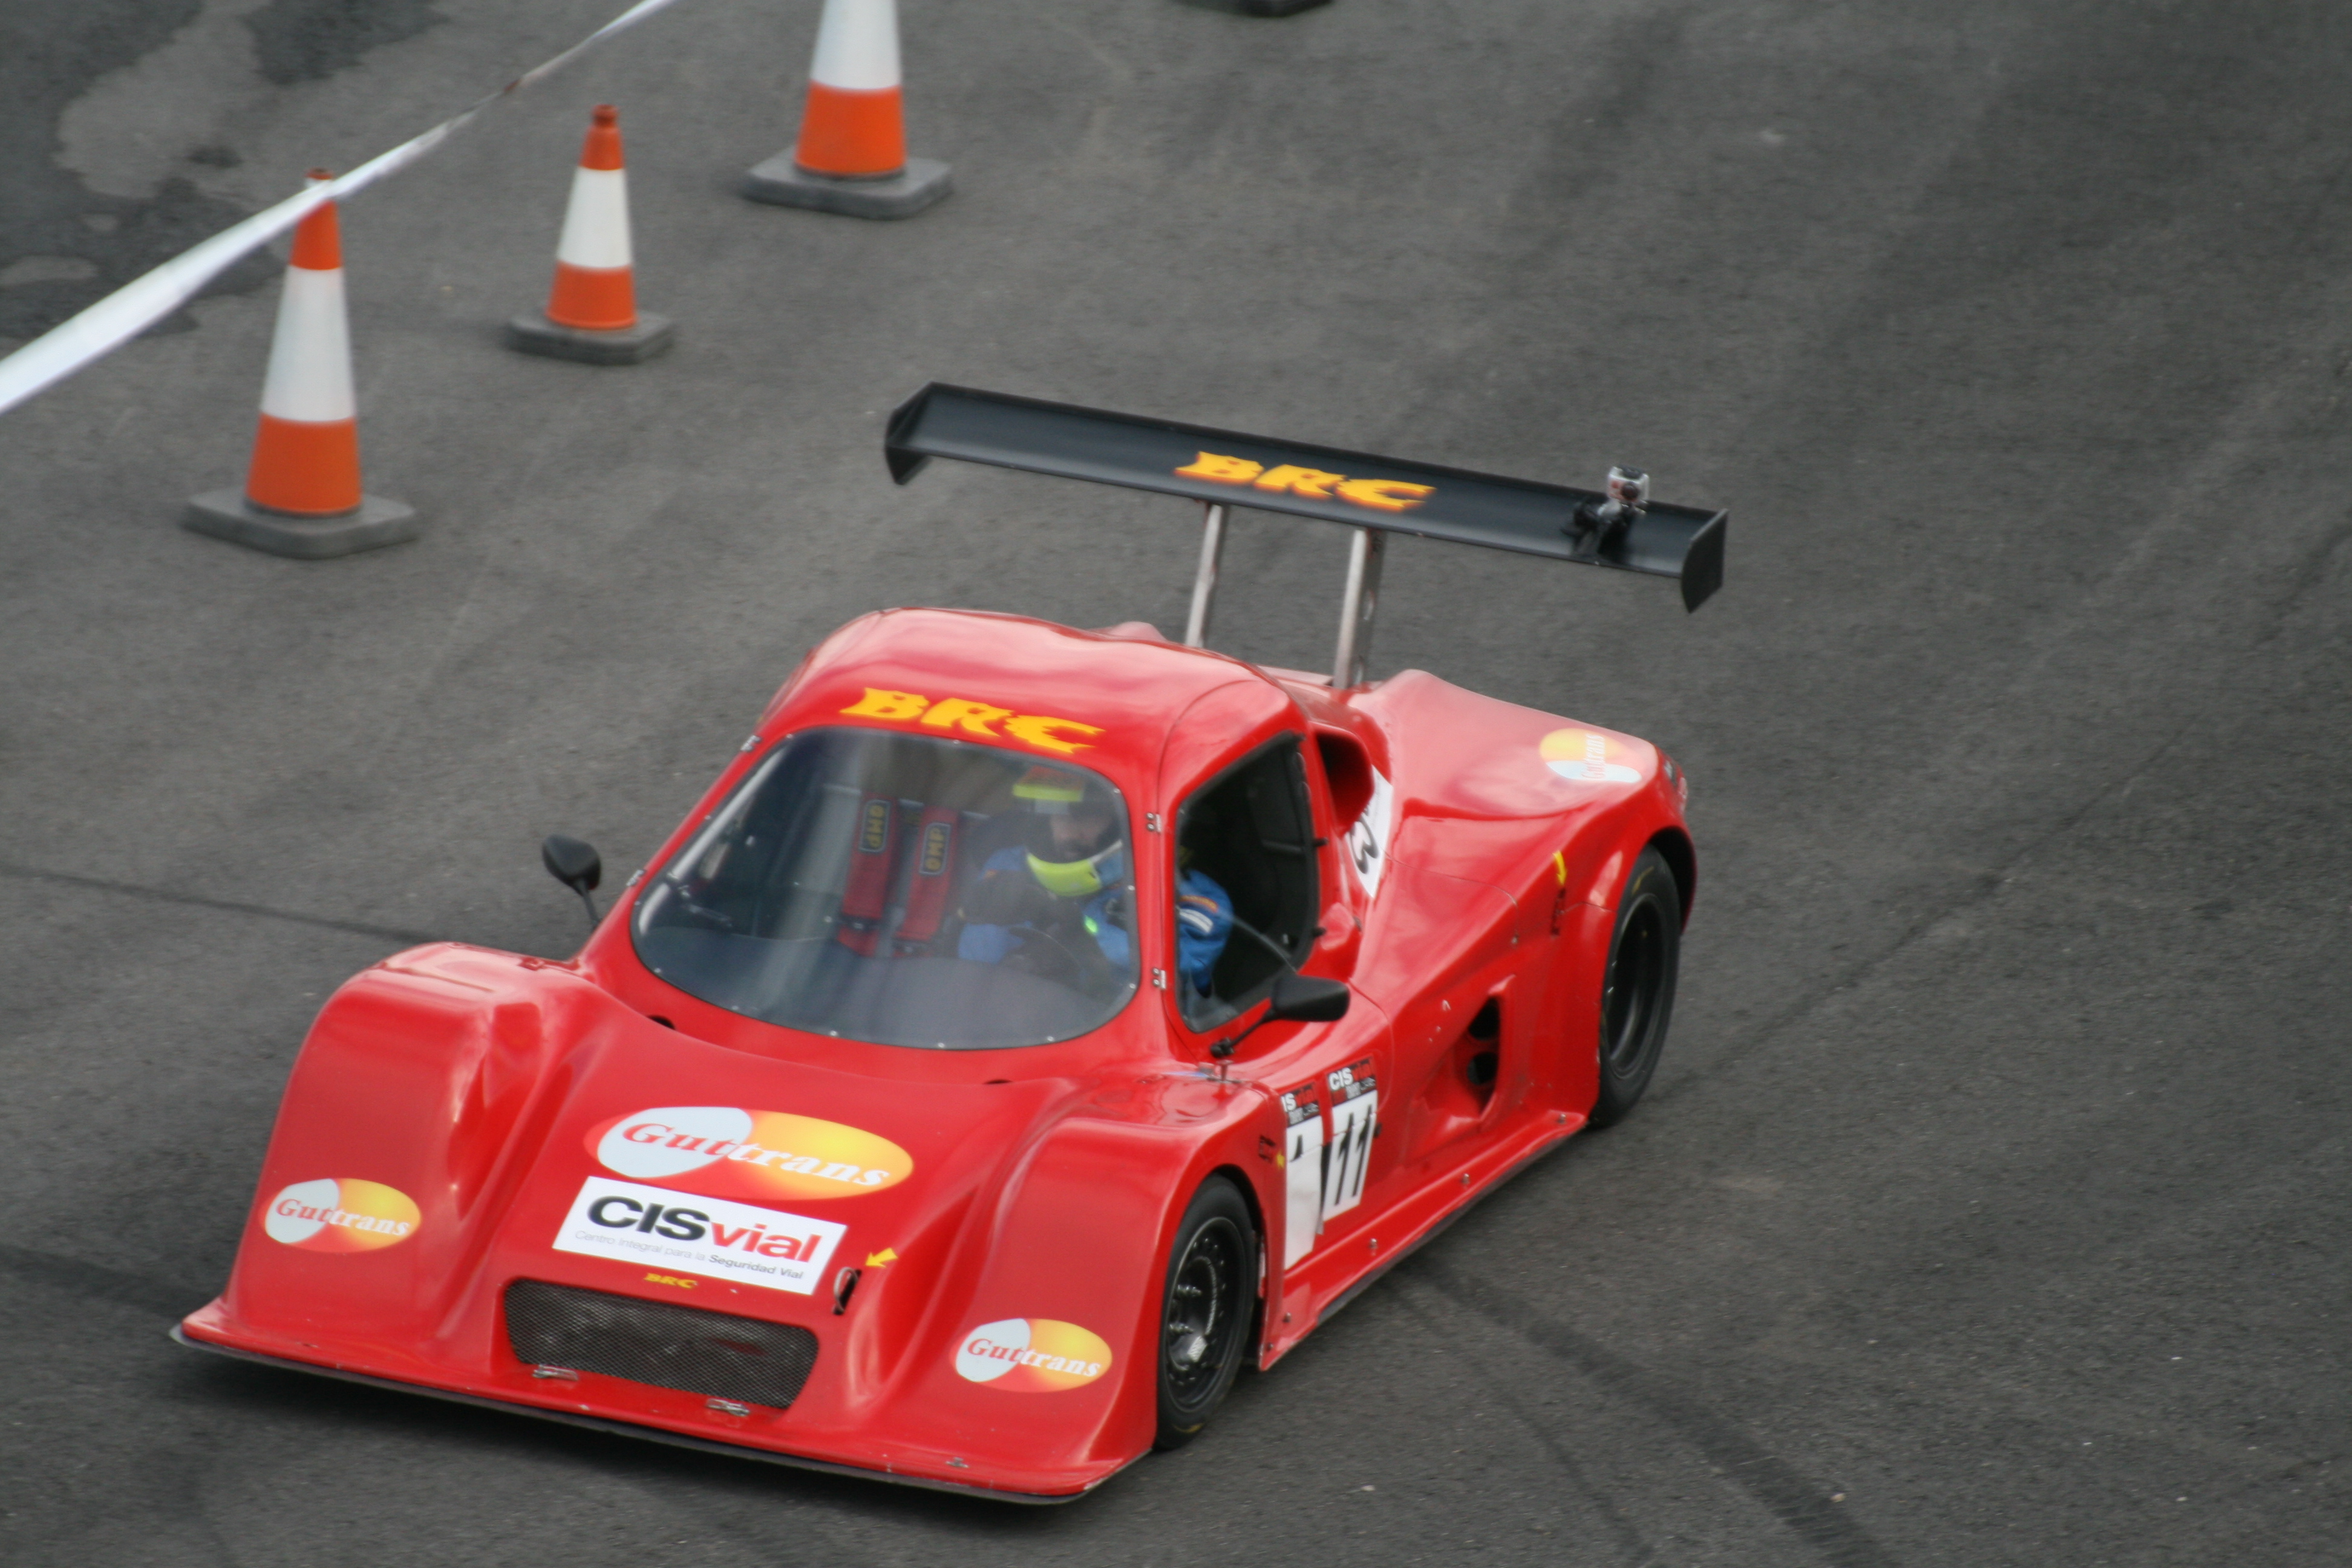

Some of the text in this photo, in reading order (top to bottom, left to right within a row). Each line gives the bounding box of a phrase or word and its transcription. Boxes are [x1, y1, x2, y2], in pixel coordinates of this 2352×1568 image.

[1174, 451, 1436, 512] BRC
[839, 687, 1106, 753] BRC
[866, 805, 885, 847] OMP
[924, 827, 945, 871] OMP
[1281, 1093, 1297, 1112] IS
[622, 1123, 890, 1186] Guttrans
[276, 1198, 411, 1236] Guttrans
[587, 1195, 822, 1263] CISvial
[575, 1230, 805, 1279] Centro Integral para la Seguridad Vial
[642, 1272, 698, 1289] BRC
[968, 1338, 1101, 1377] Guttrans
